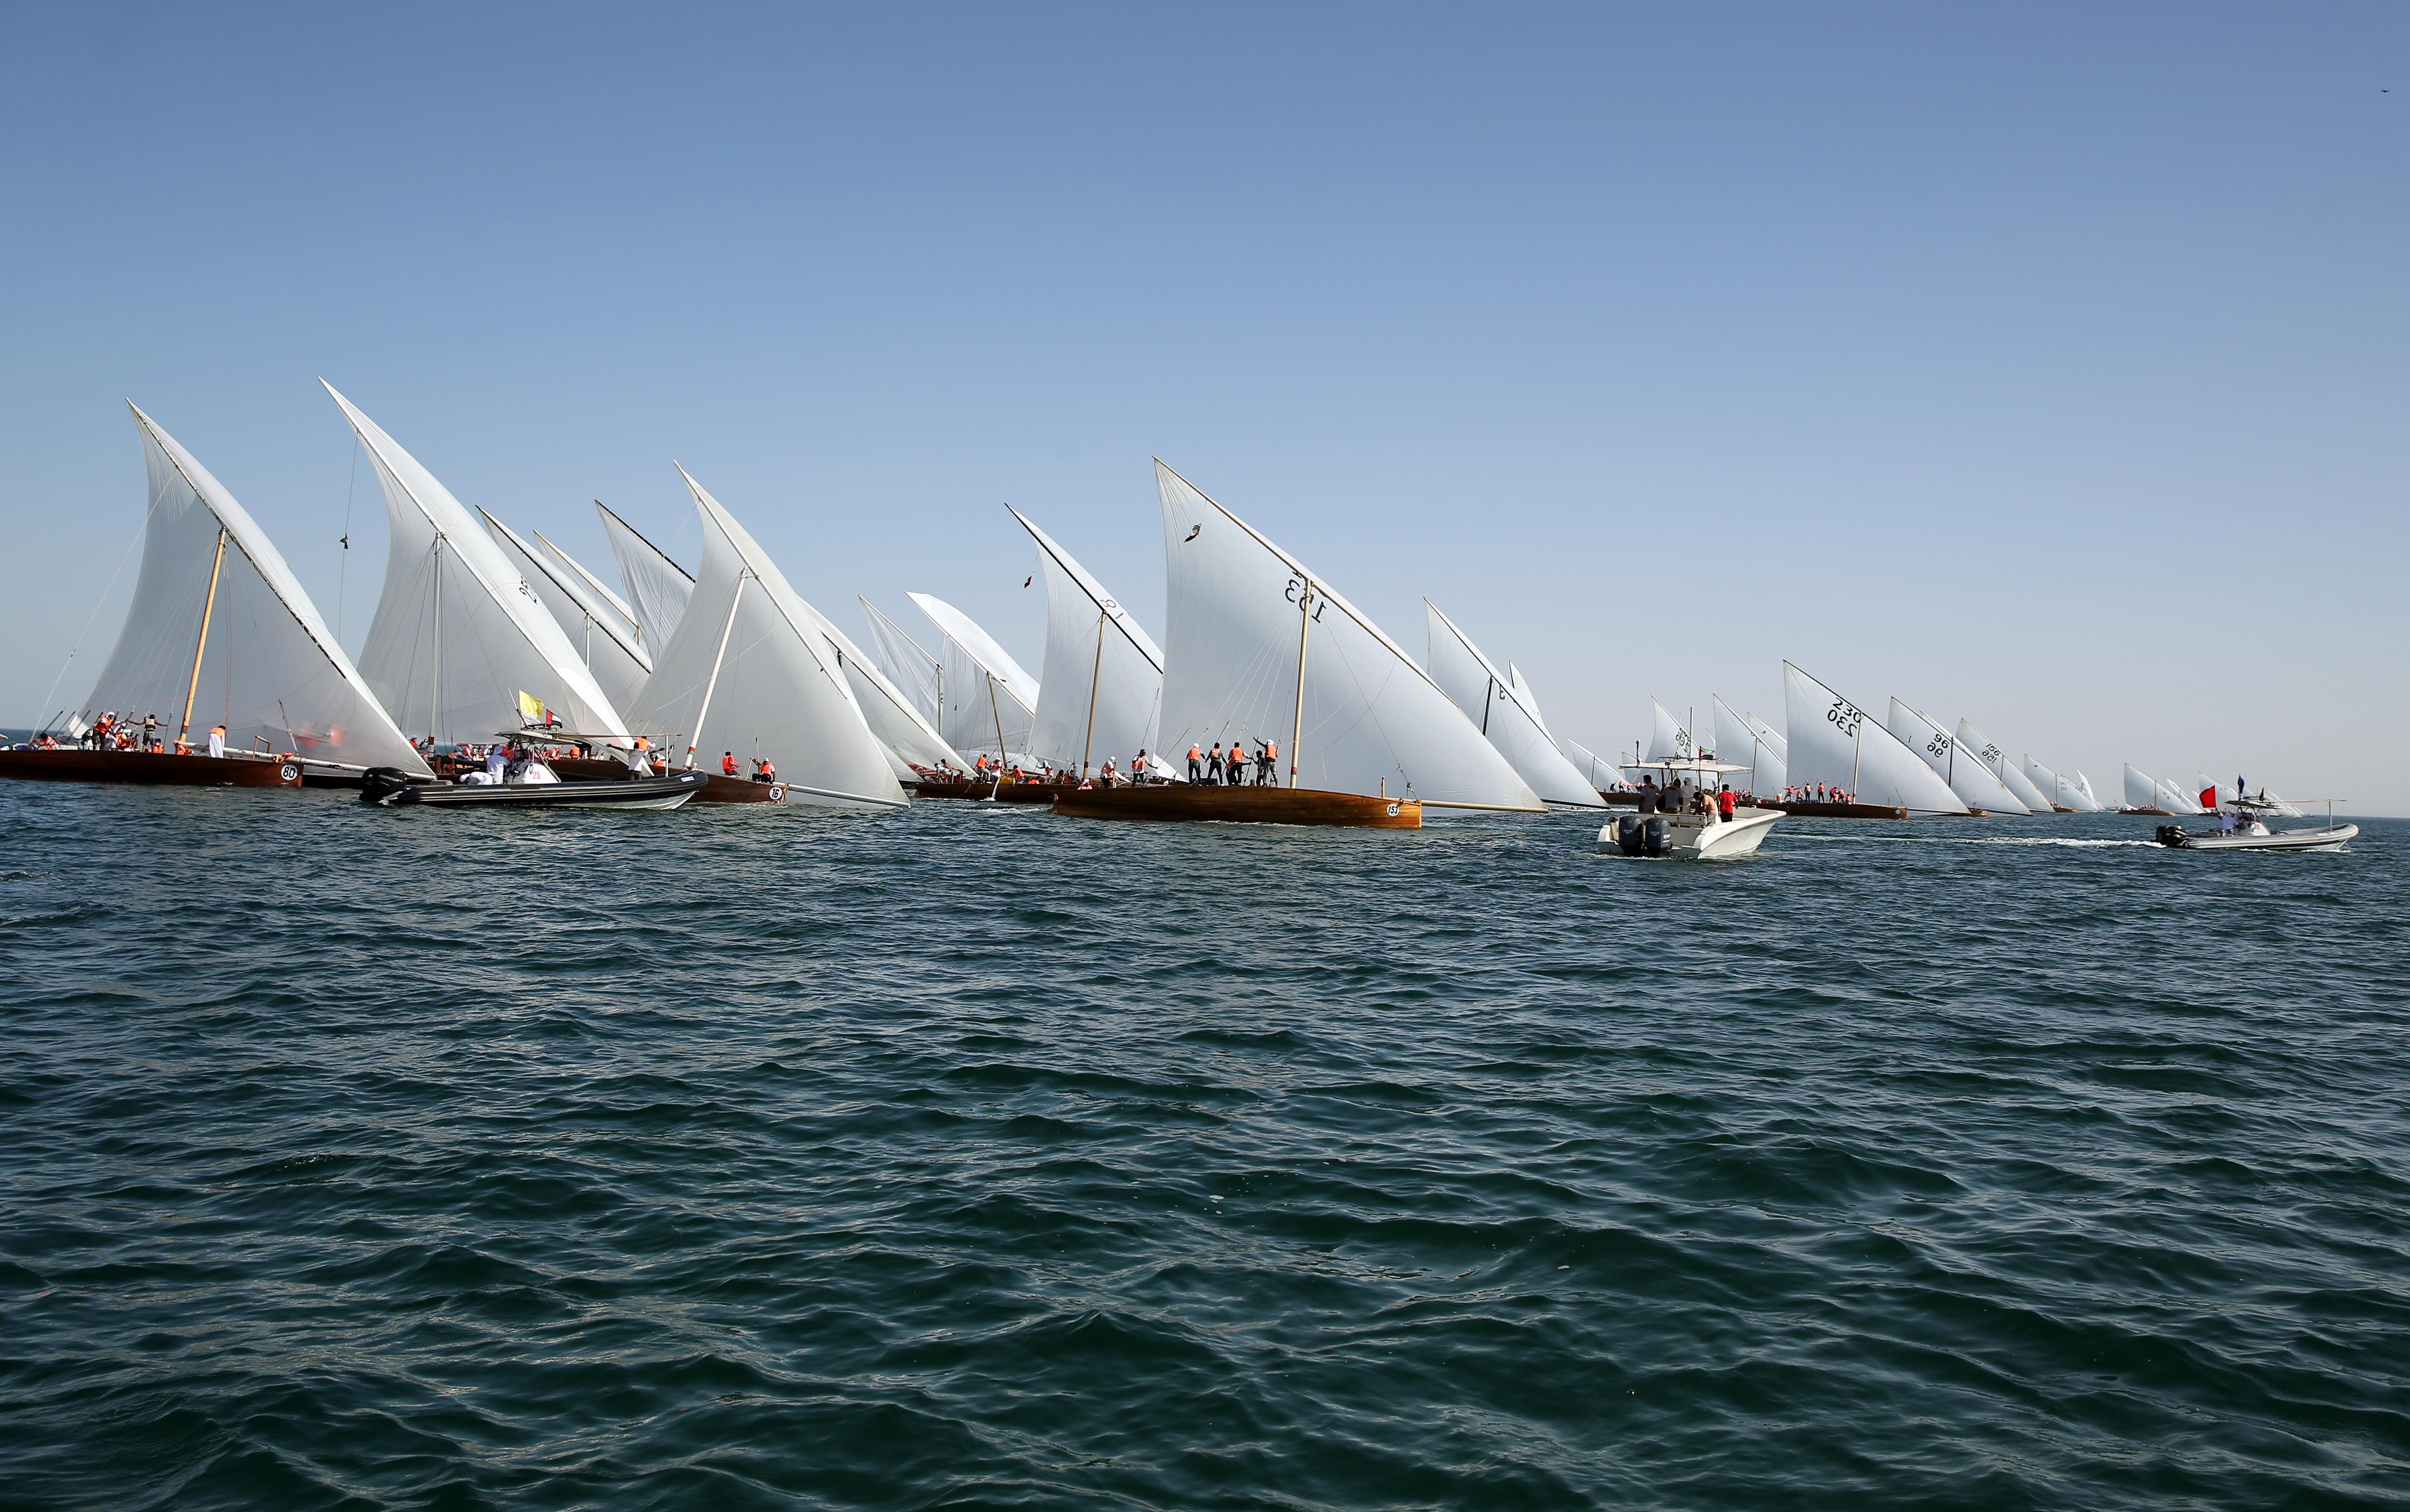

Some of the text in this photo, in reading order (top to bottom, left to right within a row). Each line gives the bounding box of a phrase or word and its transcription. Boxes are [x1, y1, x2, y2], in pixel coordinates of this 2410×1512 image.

[1833, 697, 1862, 723] 230
[1934, 734, 1949, 748] 96
[1986, 743, 2001, 756] 156
[283, 767, 295, 778] 80
[772, 788, 780, 798] 16
[1388, 806, 1398, 814] 153
